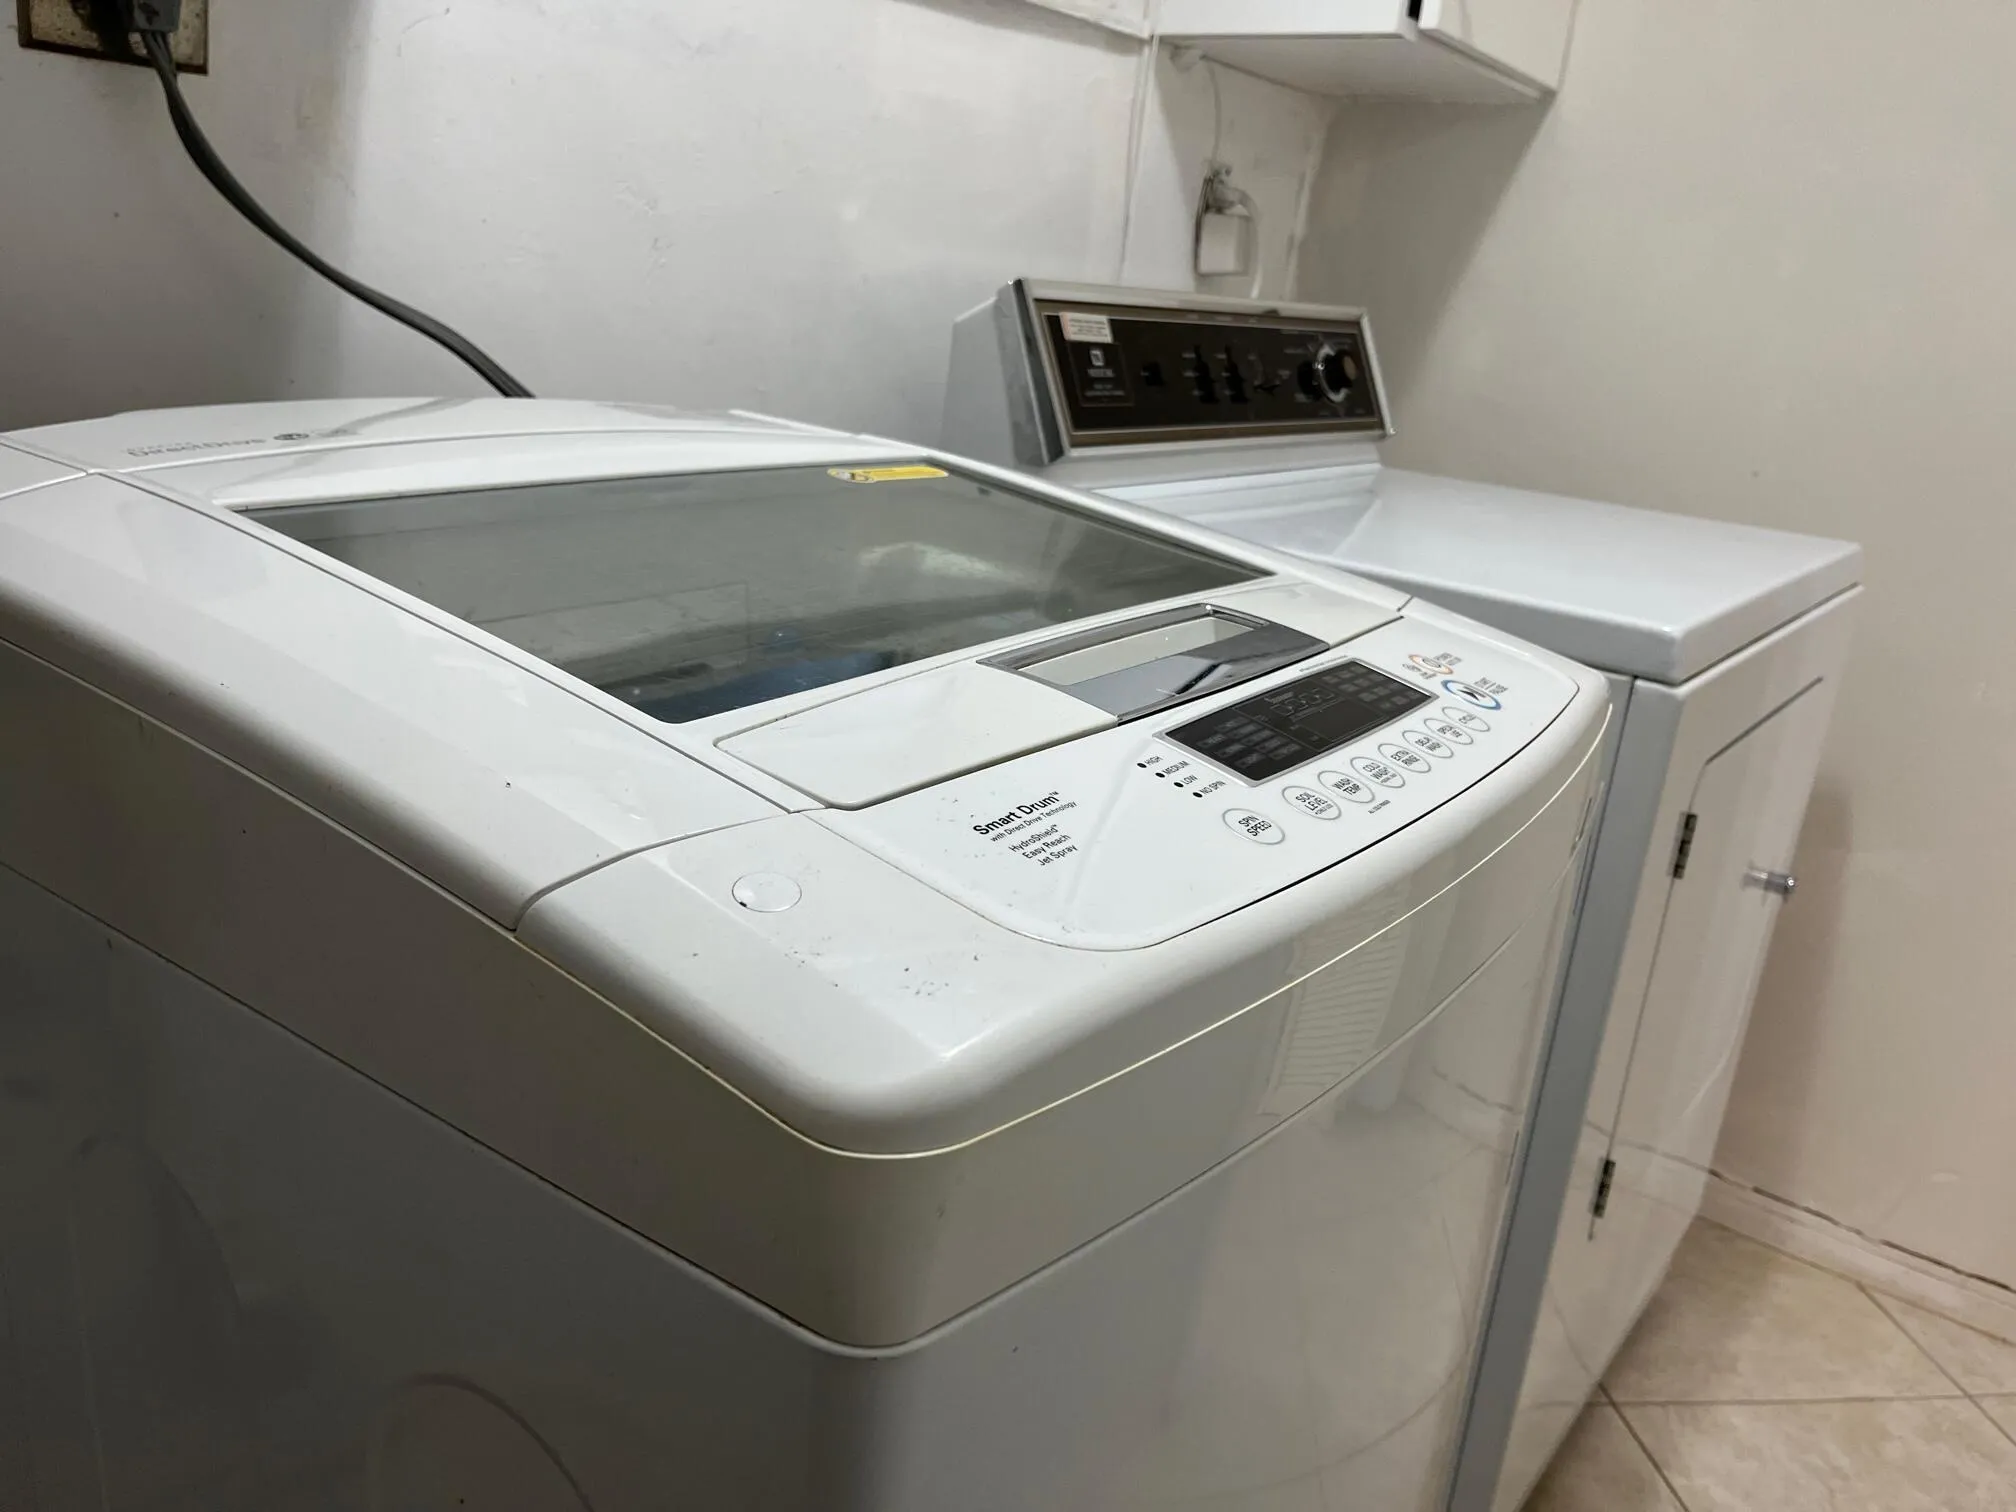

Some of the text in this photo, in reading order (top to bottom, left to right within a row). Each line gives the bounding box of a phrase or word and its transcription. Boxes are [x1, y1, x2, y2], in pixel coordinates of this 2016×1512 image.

[1144, 755, 1163, 766] HIGH
[1390, 749, 1410, 762] EXTRA
[1401, 754, 1420, 767] RINSE
[1161, 760, 1190, 775] MEDIUM
[1362, 762, 1380, 772] COLD
[1180, 774, 1198, 785] LOW
[1332, 777, 1352, 790] WASH
[1199, 780, 1227, 795] NO SPIN
[1342, 783, 1362, 795] TEMP
[1295, 791, 1316, 803] SOIL
[1304, 795, 1329, 811] LEVEL
[973, 811, 1022, 835] Smart
[990, 801, 1078, 842] with Direct Drive Technology
[1238, 814, 1260, 828] SPIN
[1247, 820, 1272, 837] SPEED
[1021, 833, 1072, 859] Easy Reach
[1037, 844, 1078, 866] Jet Spray
